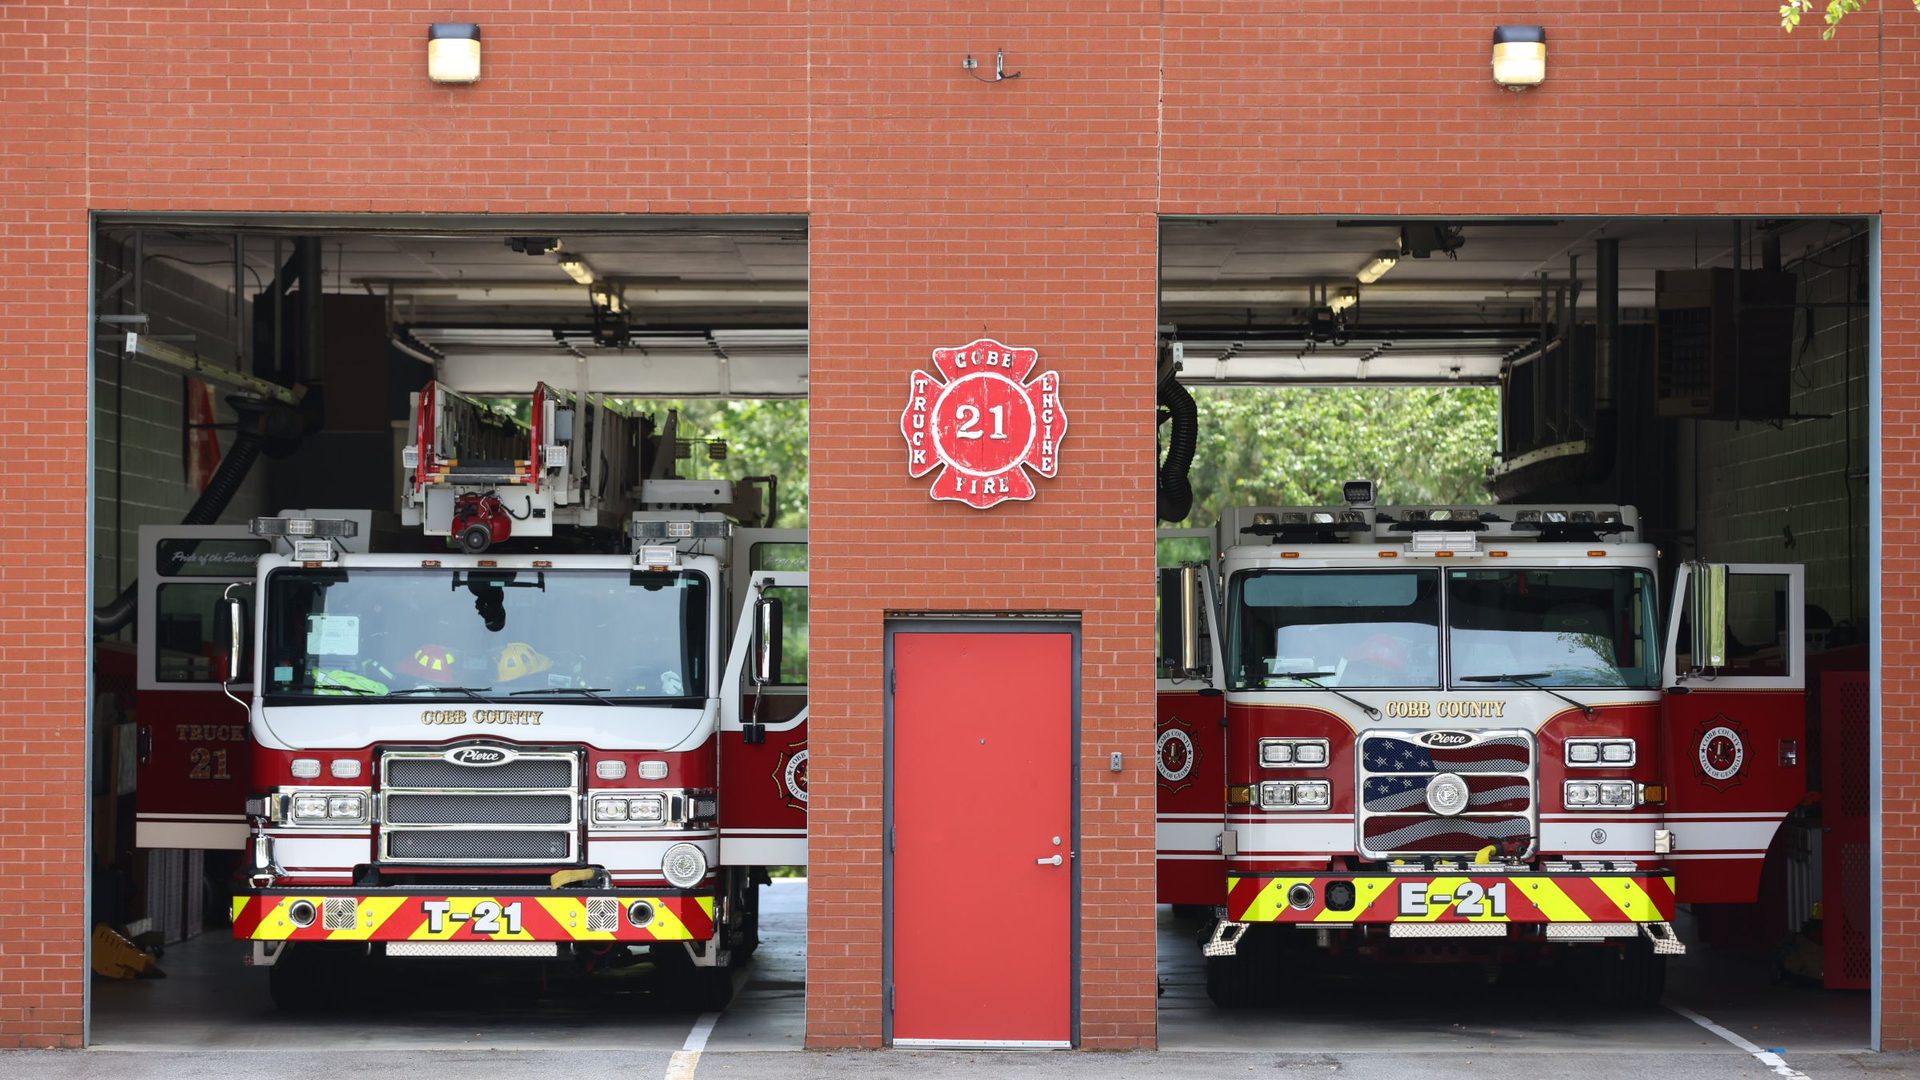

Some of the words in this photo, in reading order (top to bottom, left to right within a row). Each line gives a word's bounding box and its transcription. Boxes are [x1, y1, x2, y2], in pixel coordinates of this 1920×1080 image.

[912, 379, 928, 465] TRUCK
[955, 404, 1008, 440] 21
[1041, 377, 1054, 472] ENGINE
[956, 477, 1010, 495] FIRE
[171, 551, 197, 562] Pride
[198, 553, 210, 566] of
[208, 552, 222, 562] the
[224, 552, 260, 563] Eastsid
[421, 710, 467, 725] COBB
[472, 709, 544, 725] COUNTY
[1385, 700, 1431, 718] COBB
[1436, 700, 1506, 718] COUNTY
[176, 725, 245, 741] TRUCK
[1158, 731, 1171, 749] COBB
[1171, 730, 1191, 748] COUNTY
[1427, 732, 1466, 745] Pierce
[1702, 730, 1717, 747] COBB
[1717, 728, 1741, 746] COUNTY
[189, 747, 231, 779] 21
[460, 748, 499, 761] Pierce
[788, 752, 806, 769] COBB
[1701, 754, 1712, 775] STATE
[1720, 754, 1741, 778] GEORGIA
[787, 776, 800, 797] STATE
[1398, 881, 1507, 917] E-21
[421, 900, 522, 934] T-21
